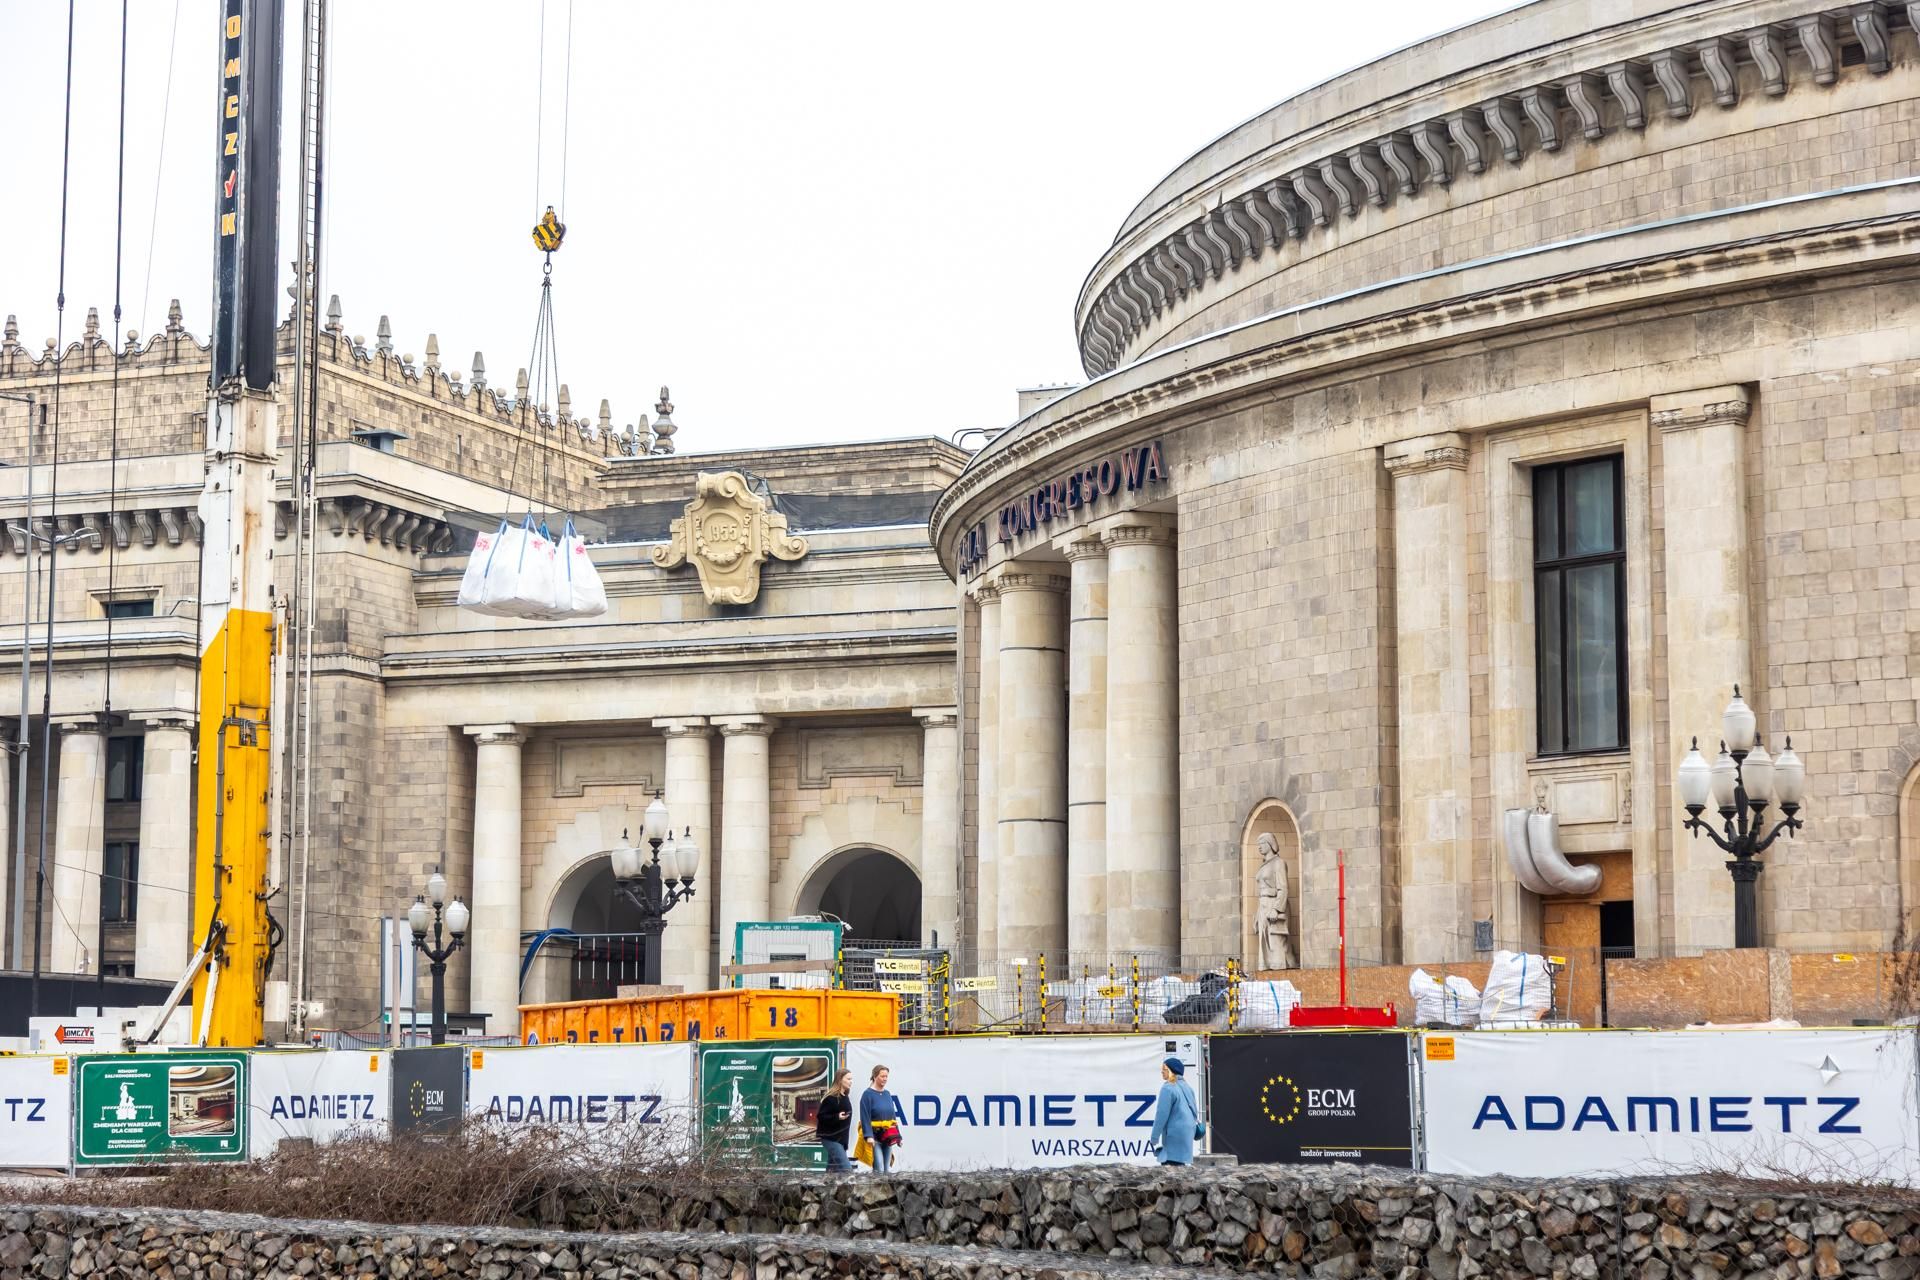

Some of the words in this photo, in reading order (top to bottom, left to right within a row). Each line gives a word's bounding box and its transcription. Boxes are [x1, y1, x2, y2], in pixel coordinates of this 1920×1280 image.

[998, 441, 1168, 543] KONGRESOWA
[709, 524, 737, 542] 1955
[877, 962, 897, 970] TLC
[426, 1090, 444, 1105] ECM
[1307, 1089, 1356, 1108] ECM
[487, 1095, 662, 1124] ADAMIETZ
[1308, 1109, 1330, 1117] GROUP
[1331, 1109, 1356, 1117] POLSKA
[1472, 1096, 1861, 1134] ADAMIETZ
[1032, 1139, 1158, 1157] WARSZAWA
[1300, 1149, 1322, 1157] nadzór
[1324, 1149, 1362, 1157] inwestorski
